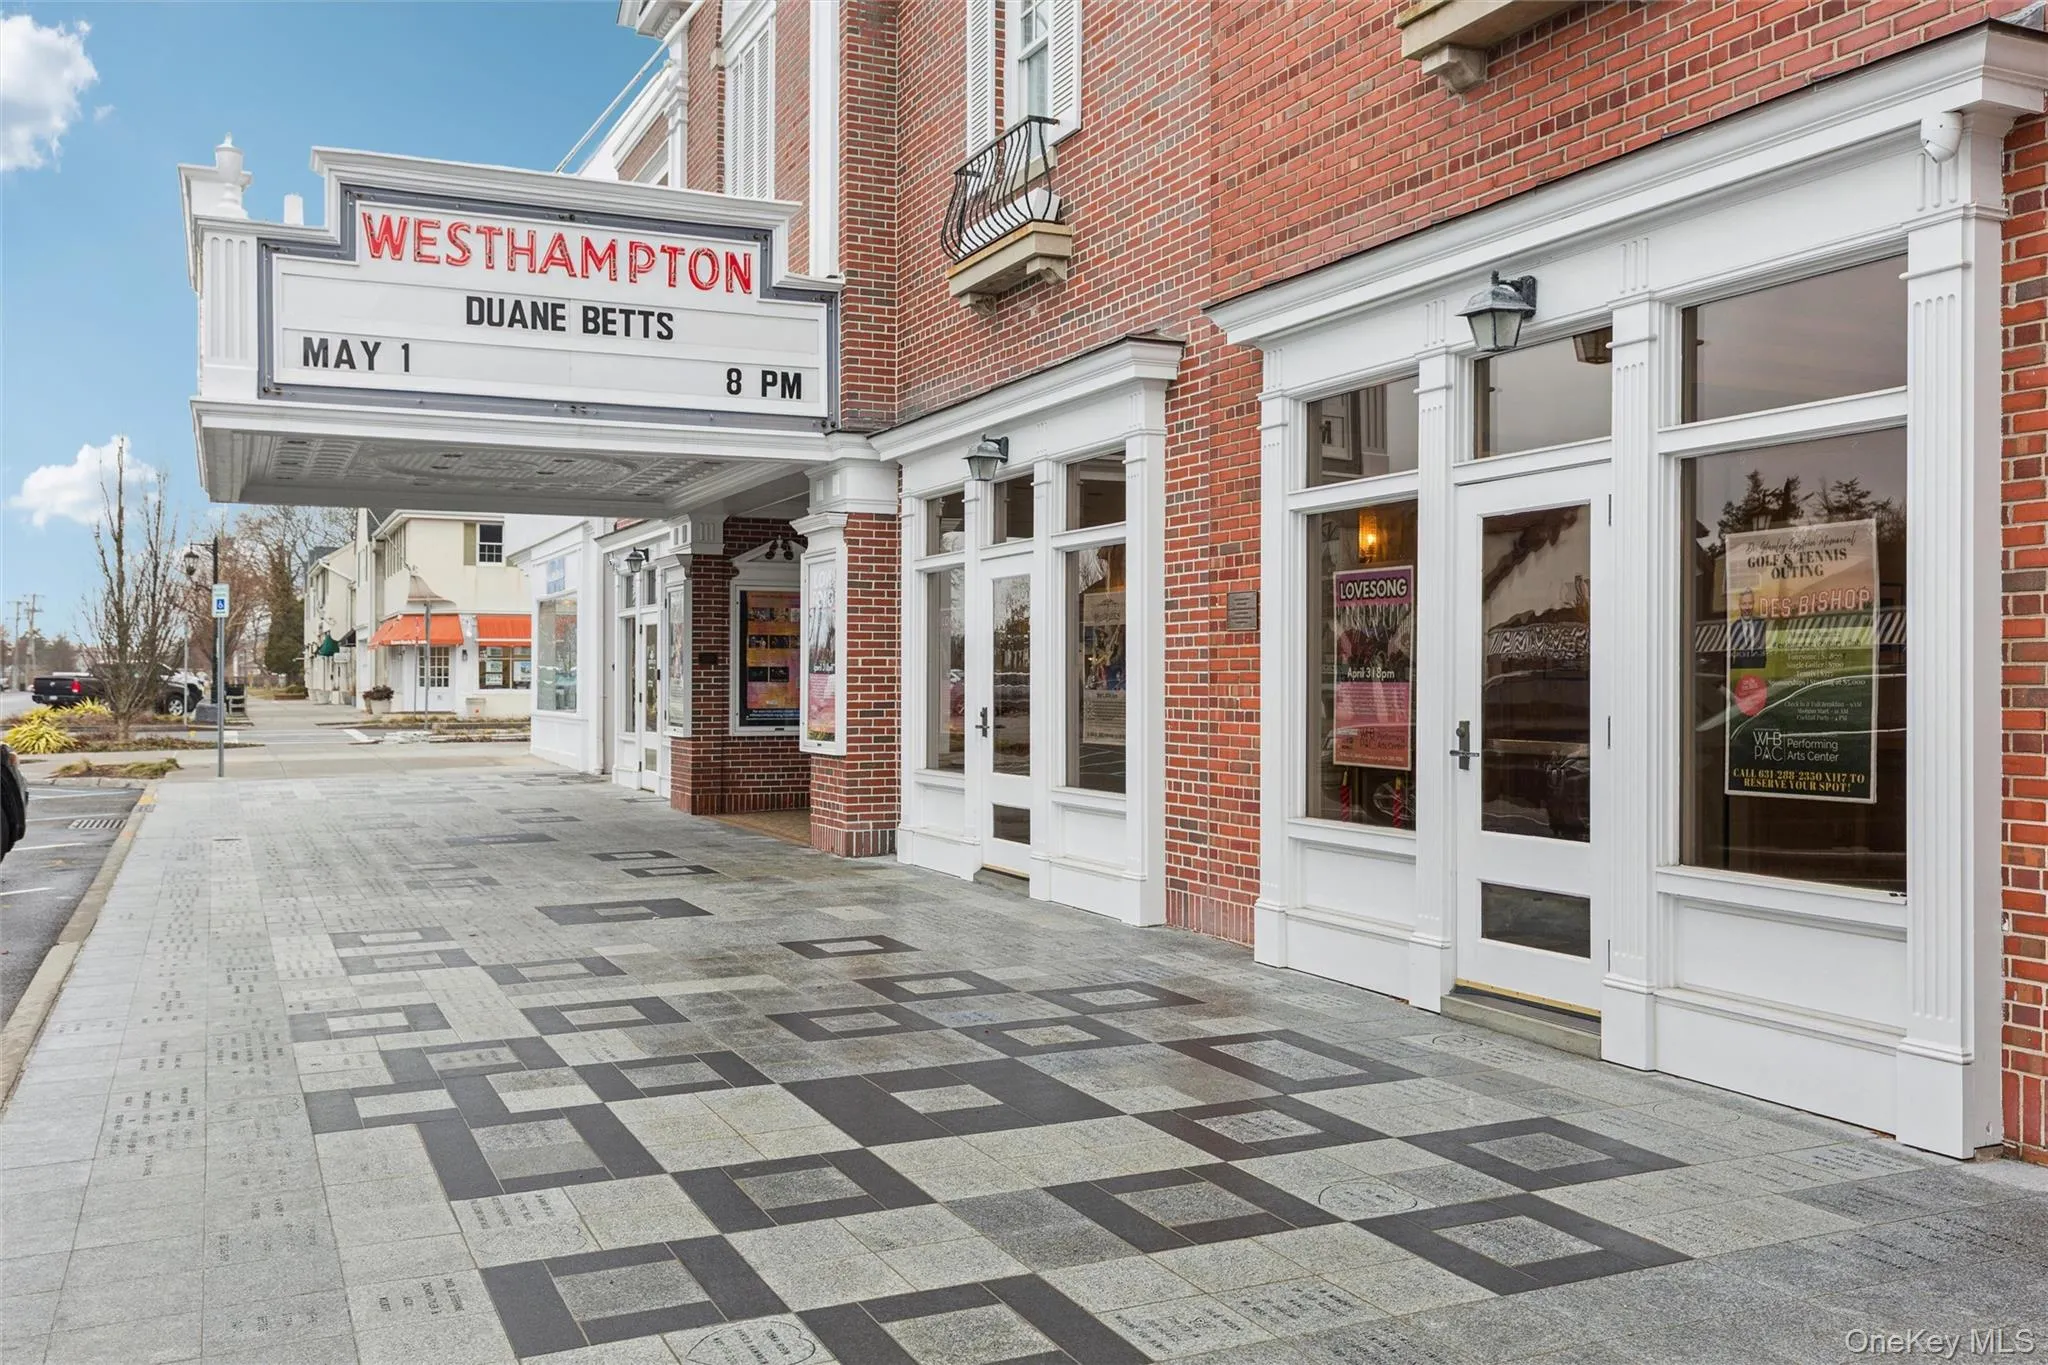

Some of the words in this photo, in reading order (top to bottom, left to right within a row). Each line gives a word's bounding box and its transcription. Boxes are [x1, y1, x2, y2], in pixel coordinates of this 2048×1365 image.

[363, 213, 752, 294] WESTHAMPTON
[467, 296, 566, 332] DUANE
[583, 306, 674, 341] BETTS
[304, 337, 381, 371] MAY
[401, 343, 410, 373] 1
[726, 368, 742, 396] 8
[761, 370, 802, 400] PM
[1747, 554, 1780, 568] GOLF
[1783, 553, 1794, 569] &
[1797, 548, 1848, 564] TENNIS
[1771, 564, 1824, 580] OUTING
[1339, 578, 1408, 600] LOVESONG
[1759, 597, 1791, 618] DES
[1797, 588, 1870, 616] BISHOP
[1347, 667, 1365, 681] April
[1376, 667, 1395, 681] 8pm
[1754, 746, 1783, 761] PAC
[1787, 738, 1839, 752] Performing
[1787, 751, 1806, 761] Arts
[1807, 752, 1840, 762] Center
[1733, 768, 1757, 778] CALL
[1849, 774, 1865, 784] TO
[1744, 778, 1788, 789] RESERVE
[1789, 779, 1817, 791] YOUR
[1819, 782, 1852, 793] SPOT!
